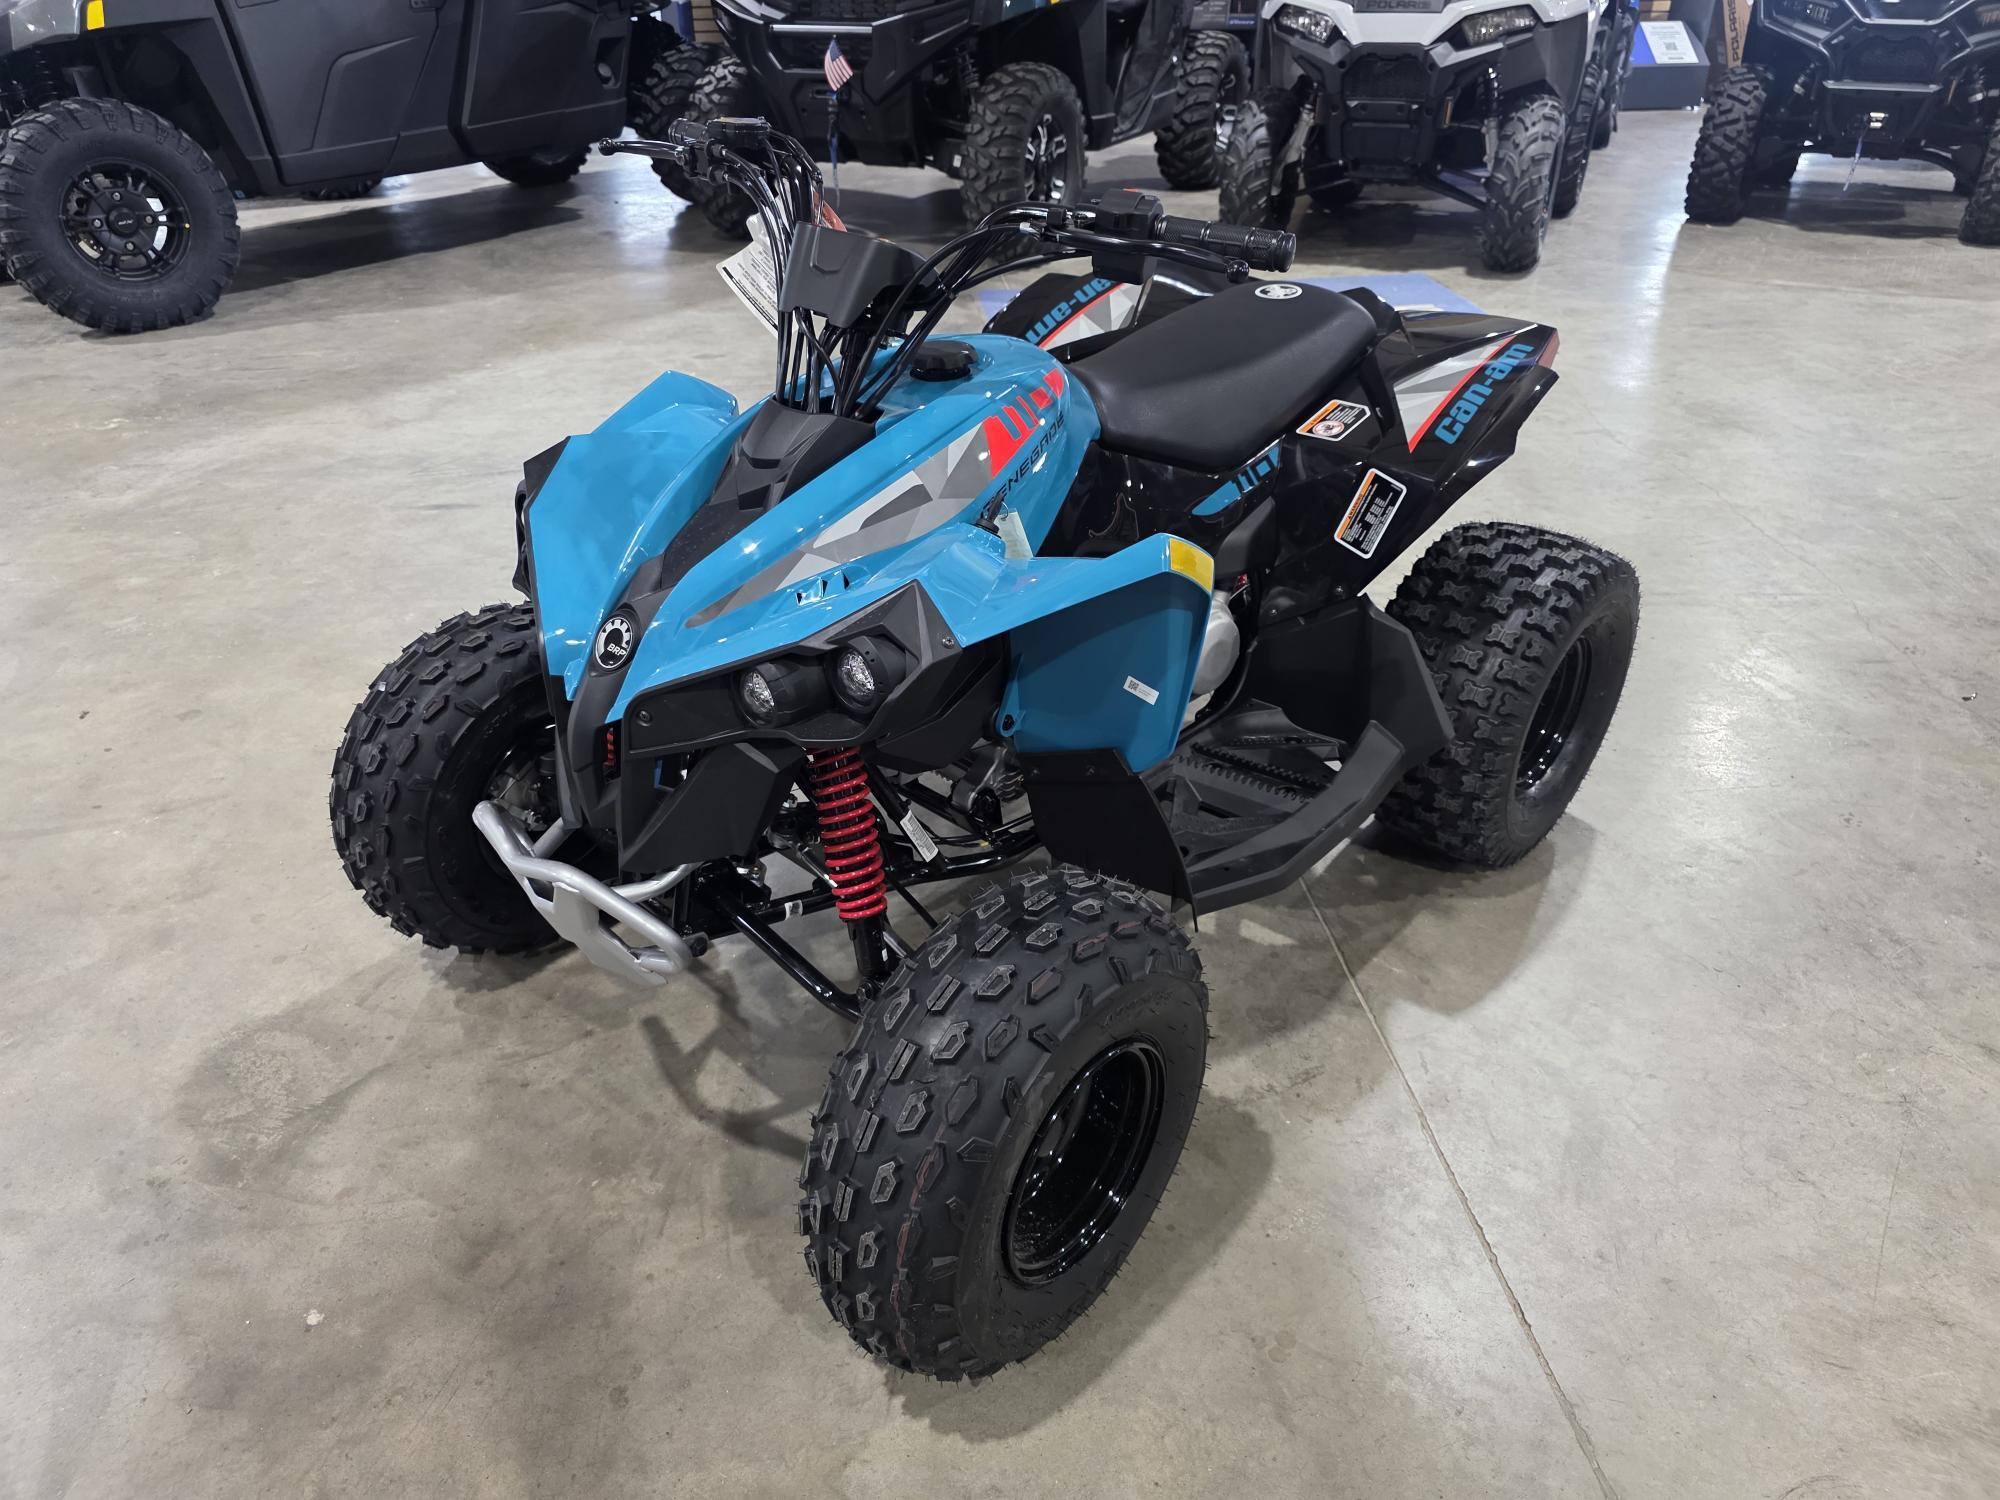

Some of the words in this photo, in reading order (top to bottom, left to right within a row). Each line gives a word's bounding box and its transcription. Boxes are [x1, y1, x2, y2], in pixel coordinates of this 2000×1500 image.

[1025, 278, 1114, 344] an-am
[1435, 343, 1534, 445] can-am
[606, 642, 627, 656] BRP
